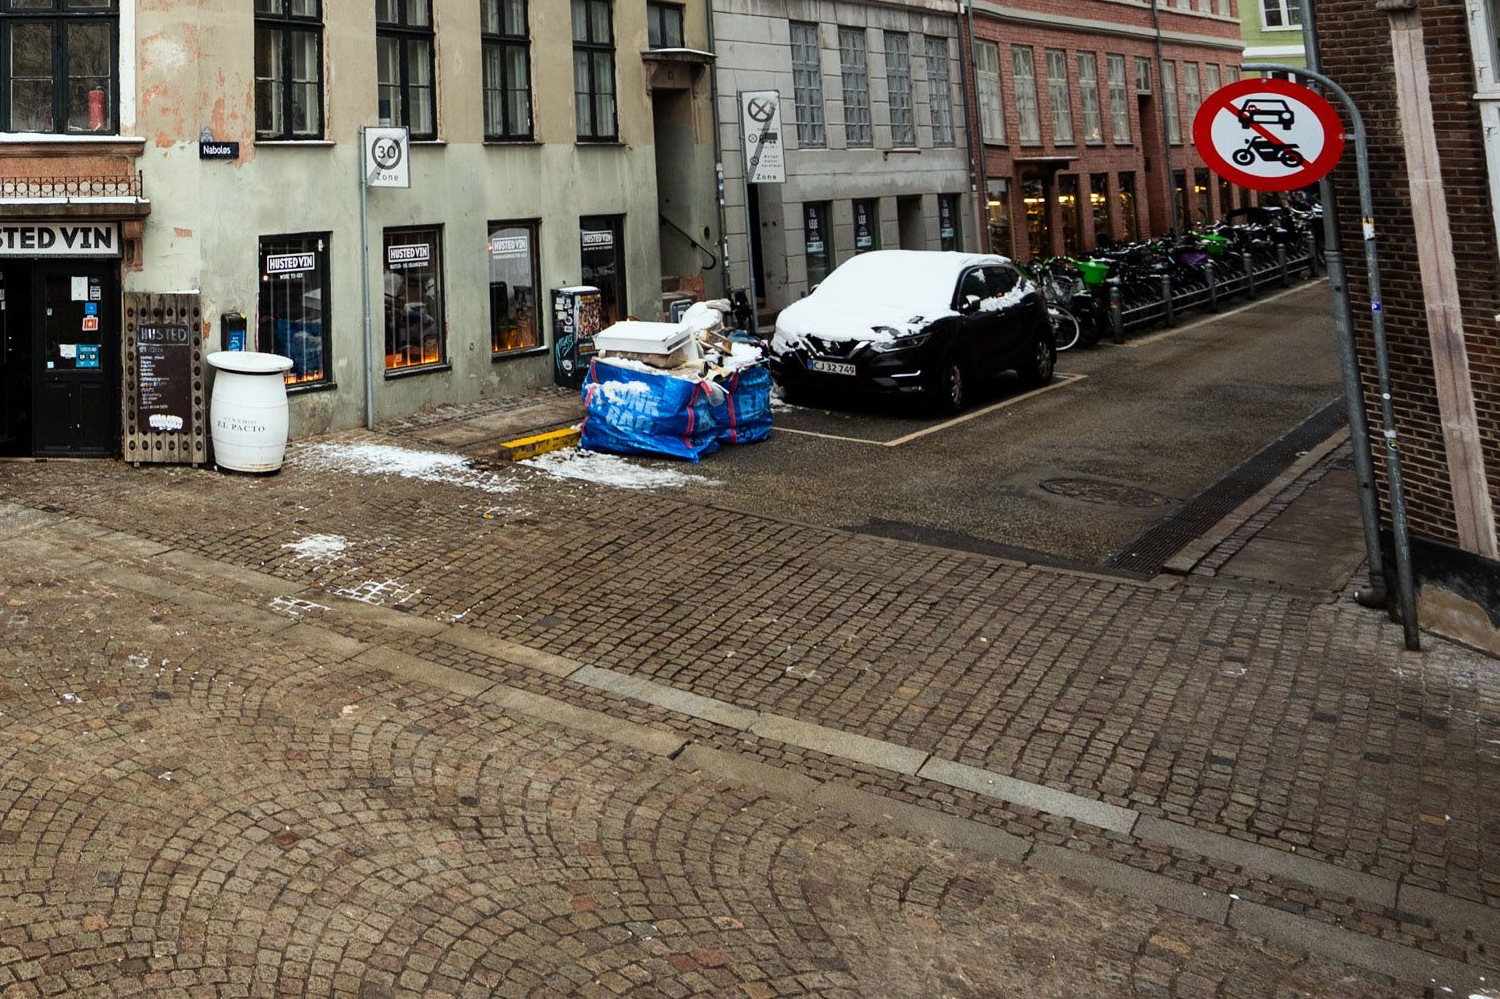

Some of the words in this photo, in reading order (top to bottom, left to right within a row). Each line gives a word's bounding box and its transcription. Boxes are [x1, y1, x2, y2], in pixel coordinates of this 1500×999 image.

[203, 145, 231, 155] Naboløs
[378, 145, 396, 159] 30
[376, 172, 399, 181] Zone
[60, 227, 112, 249] VIN
[494, 240, 515, 251] HUSTED
[390, 248, 415, 259] HUSTED
[415, 247, 427, 257] VIN
[269, 258, 298, 270] HUSTED
[298, 256, 313, 267] VIN
[141, 328, 187, 341] HUSTED
[814, 362, 825, 370] CJ
[827, 363, 837, 371] 32
[838, 364, 854, 373] 749
[217, 420, 228, 429] EL
[231, 423, 266, 432] PACTO
